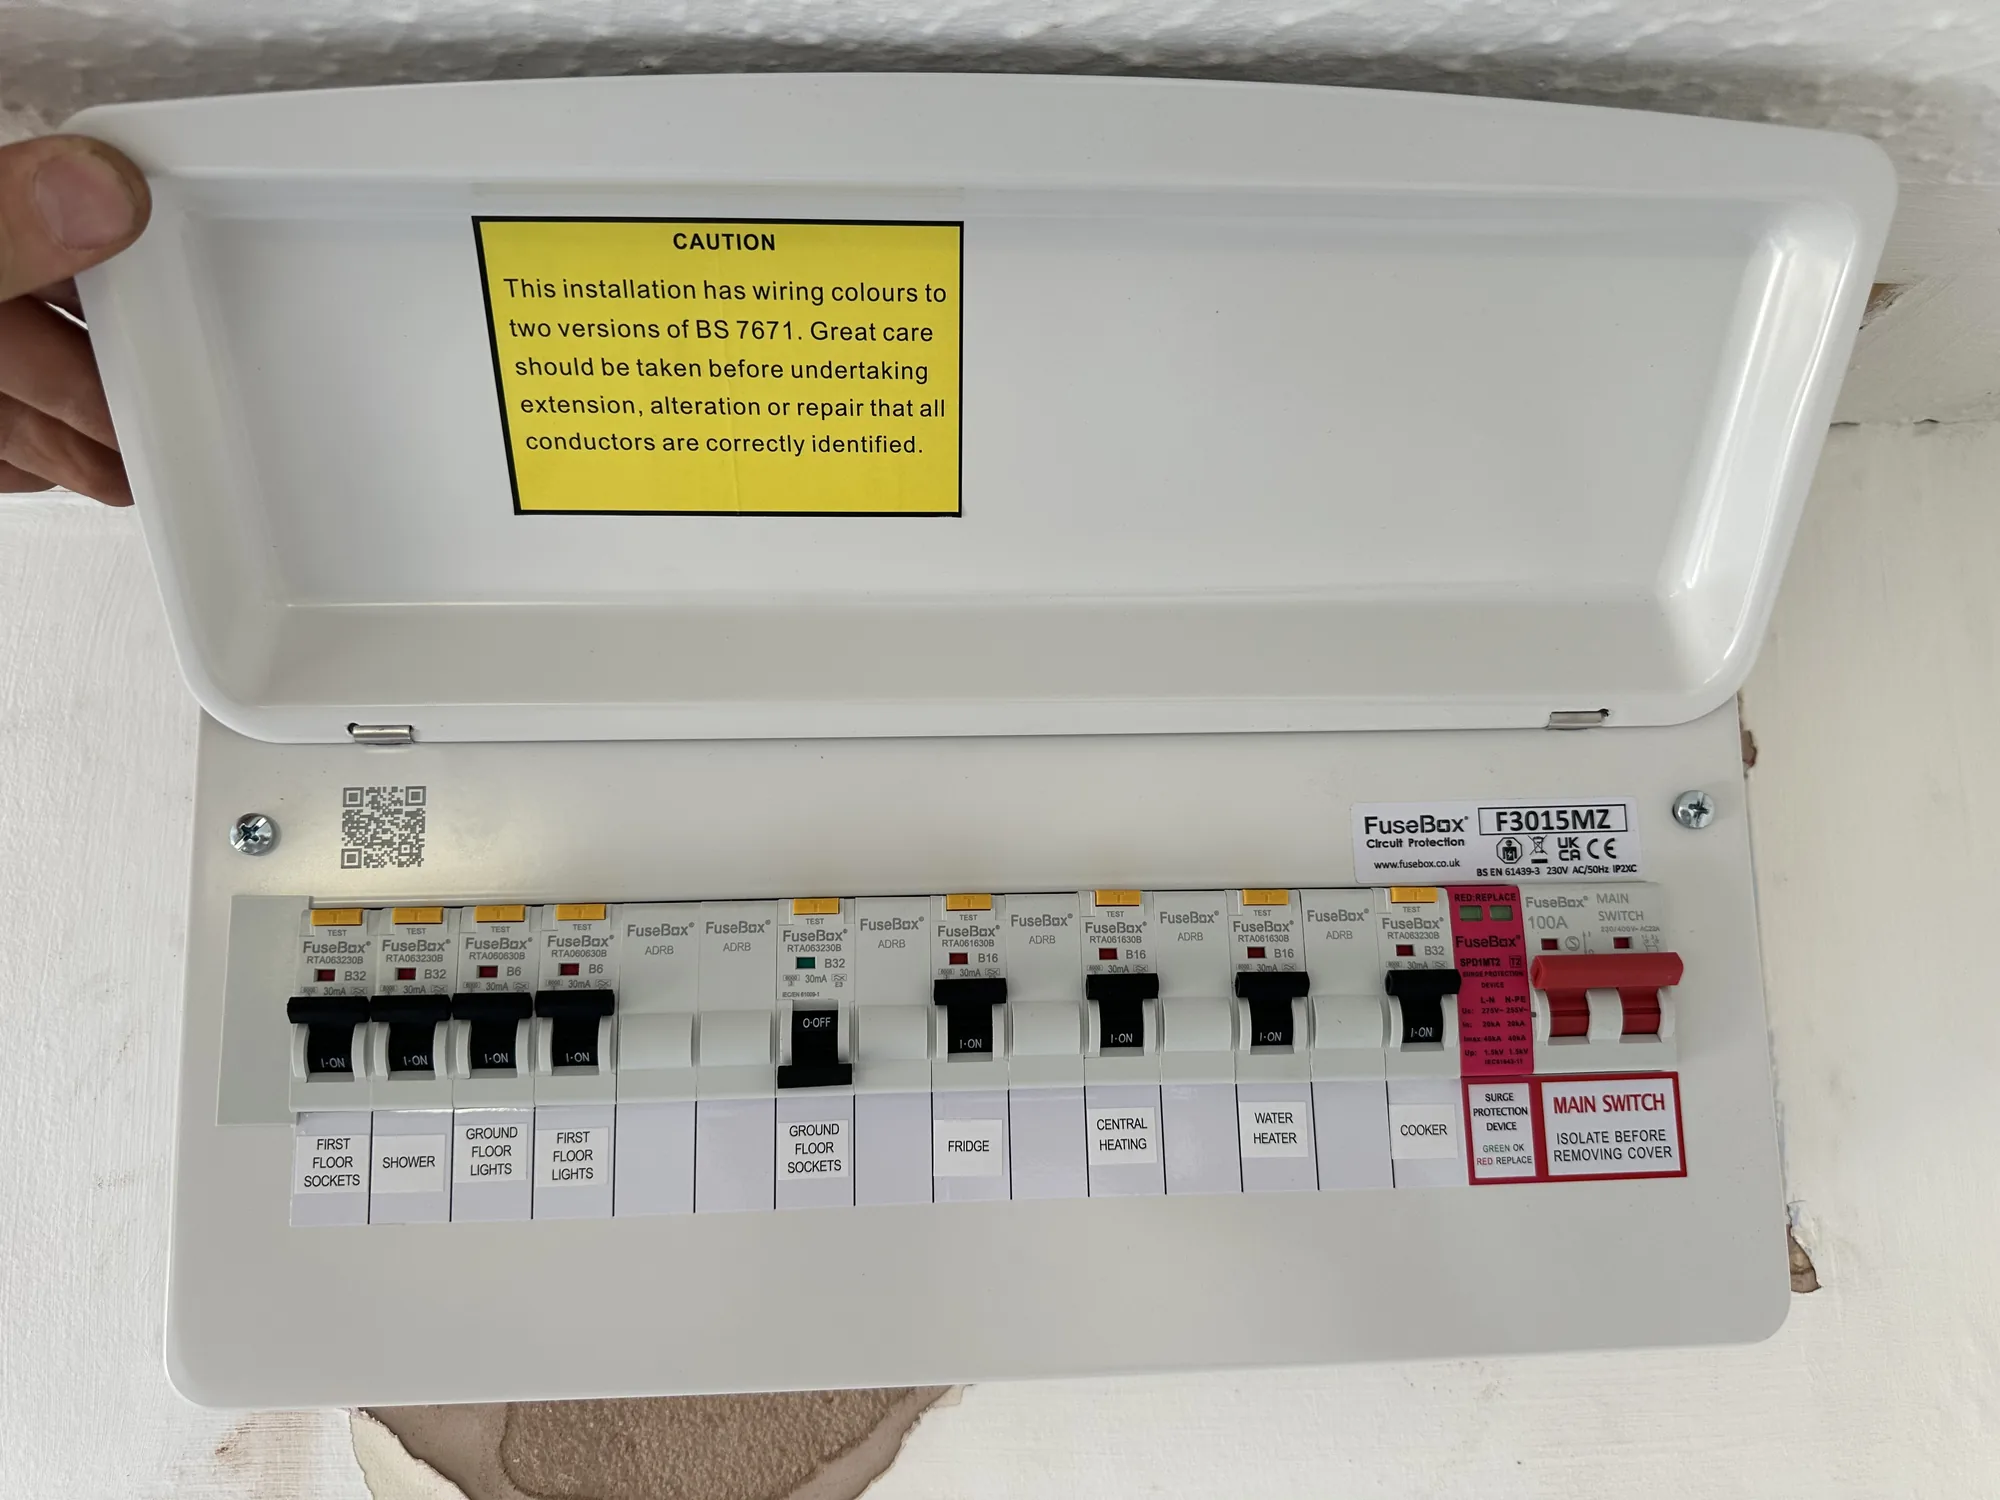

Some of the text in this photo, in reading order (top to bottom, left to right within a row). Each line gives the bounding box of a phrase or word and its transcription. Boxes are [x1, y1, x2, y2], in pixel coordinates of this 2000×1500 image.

[672, 232, 777, 252] CAUTION
[503, 277, 947, 306] This installation has wiring colours to
[508, 318, 934, 343] two versions of BS 7671. Great care
[514, 356, 929, 384] should be taken before undertaking
[520, 395, 946, 422] extension, alteration or repair that all
[525, 432, 924, 456] conductors are correctly identified.
[1364, 815, 1465, 835] FuseBox
[1496, 809, 1611, 832] F3015MZ
[1366, 837, 1465, 849] Circuit Protection
[1557, 837, 1579, 848] UK
[1587, 838, 1617, 859] CE
[1374, 858, 1460, 870] www.fusebox.co.uk
[1476, 864, 1637, 877] BS EN 61439-3 230V AC/50Hz IP2XC
[1525, 896, 1585, 908] FuseBox
[1596, 893, 1629, 904] MAIN
[1106, 910, 1125, 918] TEST
[1253, 909, 1272, 917] TEST
[1402, 905, 1421, 913] TEST
[805, 917, 824, 926] TEST
[1010, 914, 1069, 927] FuseBox
[1159, 911, 1215, 925] FuseBox
[1307, 909, 1365, 922] FuseBox
[1598, 910, 1644, 921] SWITCH
[572, 923, 593, 931] TEST
[705, 921, 766, 934] FuseBox
[859, 917, 920, 931] FuseBox
[1084, 921, 1143, 934] FuseBox
[1233, 920, 1290, 933] FuseBox
[1382, 917, 1440, 929] FuseBox
[1527, 916, 1568, 929] 100A
[327, 929, 347, 937] TEST
[406, 927, 427, 935] TEST
[491, 925, 511, 934] TEST
[627, 923, 689, 936] FuseBox
[782, 929, 844, 942] FuseBox
[937, 924, 995, 938] FuseBox
[1325, 930, 1353, 940] ADRB
[1387, 931, 1440, 940] RTA063230B
[547, 934, 611, 948] FuseBox
[1028, 934, 1056, 945] ADRB
[1089, 935, 1142, 944] RTA061630B
[1177, 932, 1204, 942] ADRB
[1237, 934, 1290, 943] RTA061630B
[1455, 935, 1517, 948] FuseBox
[302, 940, 366, 954] FuseBox
[382, 939, 446, 952] FuseBox
[465, 937, 528, 950] FuseBox
[723, 941, 751, 952] ADRB
[787, 943, 842, 953] RTA063230B
[878, 938, 906, 949] ADRB
[941, 939, 995, 948] RTA061630B
[469, 951, 526, 961] RTA060630B
[551, 949, 607, 958] RTA060630B
[644, 945, 674, 956] ADRB
[1125, 949, 1147, 960] B16
[1274, 949, 1294, 959] B16
[1424, 946, 1445, 956] B32
[306, 954, 364, 965] RTA063230B
[386, 953, 443, 963] RTA063230B
[824, 957, 846, 969] B32
[977, 953, 998, 963] B16
[1459, 957, 1521, 967] SPD1MT2 T2
[588, 963, 604, 975] B6
[1107, 964, 1130, 974] 30mA
[1407, 960, 1429, 970] 30mA
[344, 970, 367, 982] B32
[424, 968, 447, 980] B32
[506, 966, 522, 977] B6
[959, 968, 981, 978] 30mA
[568, 979, 592, 989] 30mA
[805, 973, 827, 984] 30mA
[323, 986, 347, 996] 30mA
[403, 984, 427, 994] 30mA
[485, 981, 509, 992] 30mA
[1481, 981, 1505, 989] DEVICE
[1480, 994, 1526, 1004] L-N N-PE
[1484, 1092, 1515, 1102] SURGE
[1553, 1093, 1666, 1114] MAIN SWITCH
[1254, 1111, 1294, 1124] WATER
[1473, 1106, 1528, 1117] PROTECTION
[789, 1123, 840, 1137] GROUND
[1096, 1118, 1148, 1130] CENTRAL
[1400, 1123, 1448, 1137] COOKER
[1486, 1122, 1517, 1131] DEVICE
[465, 1127, 518, 1140] GROUND
[556, 1131, 590, 1144] FIRST
[1253, 1132, 1298, 1144] HEATER
[1556, 1129, 1667, 1145] ISOLATE BEFORE
[316, 1137, 351, 1151] FIRST
[795, 1142, 834, 1155] FLOOR
[948, 1140, 990, 1152] FRIDGE
[1099, 1138, 1147, 1151] HEATING
[1482, 1143, 1525, 1153] GREEN OK
[471, 1145, 512, 1158] FLOOR
[553, 1149, 593, 1163] FLOOR
[1553, 1145, 1673, 1162] REMOVING COVER
[312, 1156, 354, 1169] FLOOR
[382, 1156, 436, 1169] SHOWER
[787, 1159, 842, 1173] SOCKETS
[1476, 1155, 1533, 1166] RED REPLACE
[470, 1163, 512, 1176] LIGHTS
[551, 1167, 594, 1181] LIGHTS
[304, 1174, 361, 1187] SOCKETS
